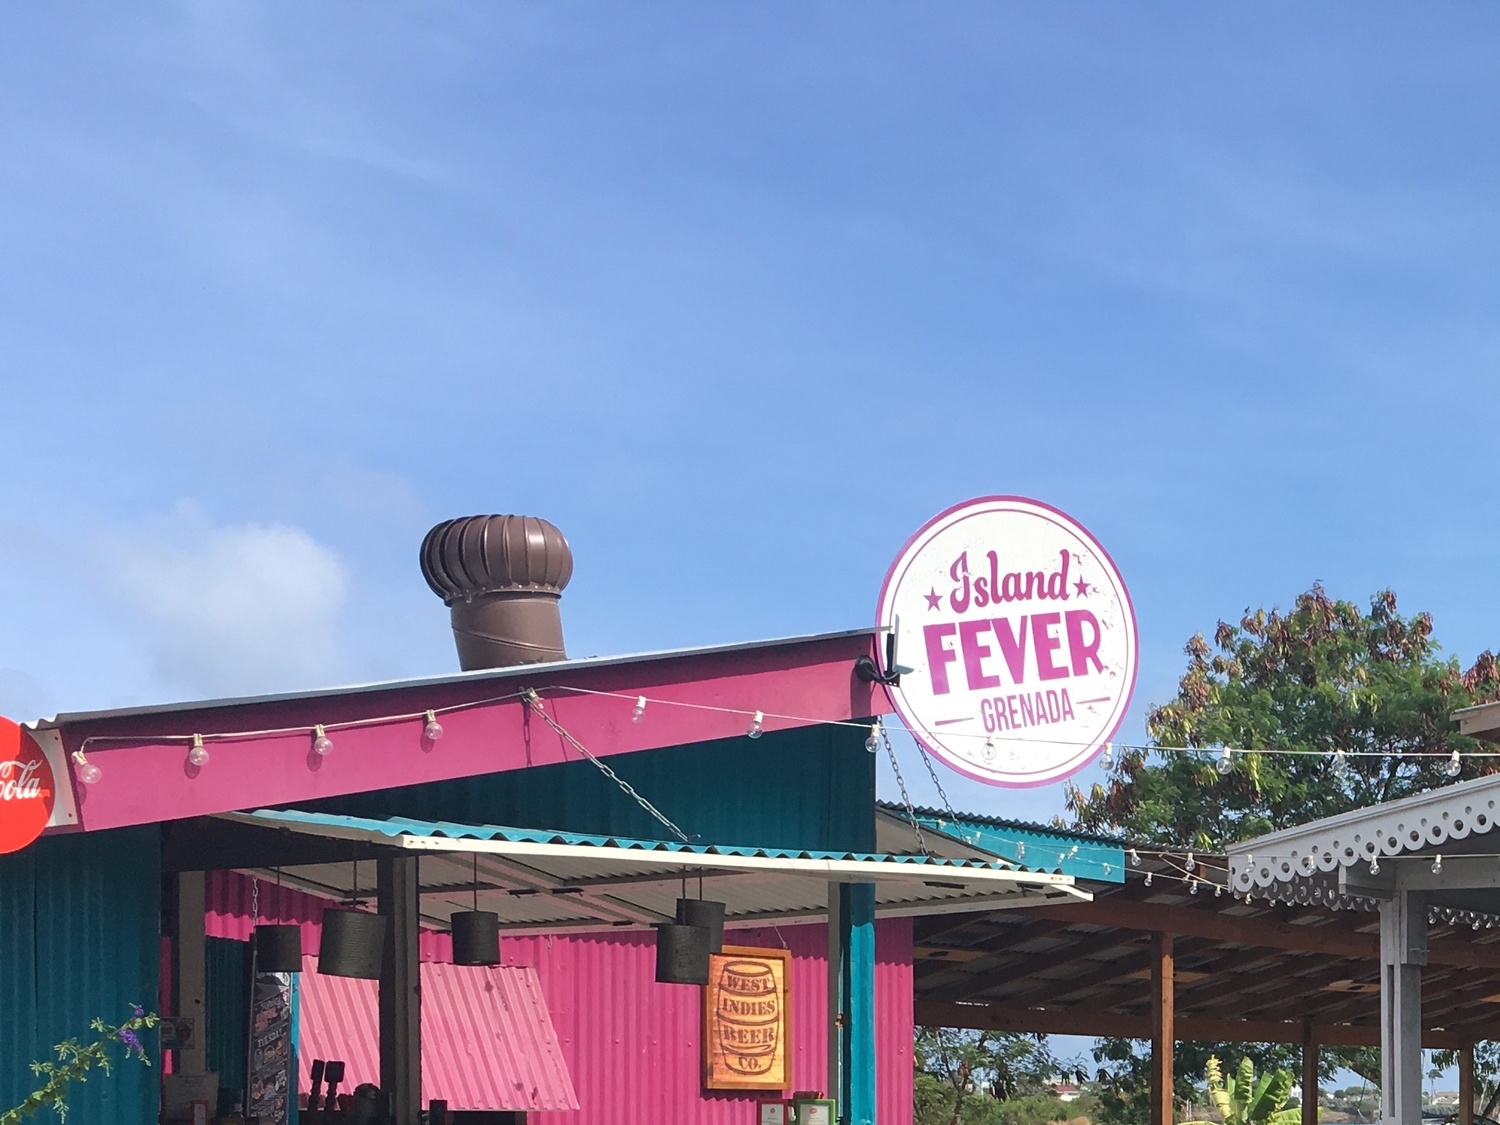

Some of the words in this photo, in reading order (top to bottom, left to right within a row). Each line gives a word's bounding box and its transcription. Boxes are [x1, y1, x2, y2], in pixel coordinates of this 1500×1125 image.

[950, 549, 1070, 614] Island
[923, 609, 1104, 695] FEVER
[981, 688, 1075, 733] GRENADA
[727, 975, 770, 990] WEST
[722, 997, 775, 1015] INDIES
[722, 1025, 775, 1044] BEER
[738, 1056, 762, 1070] CO.
